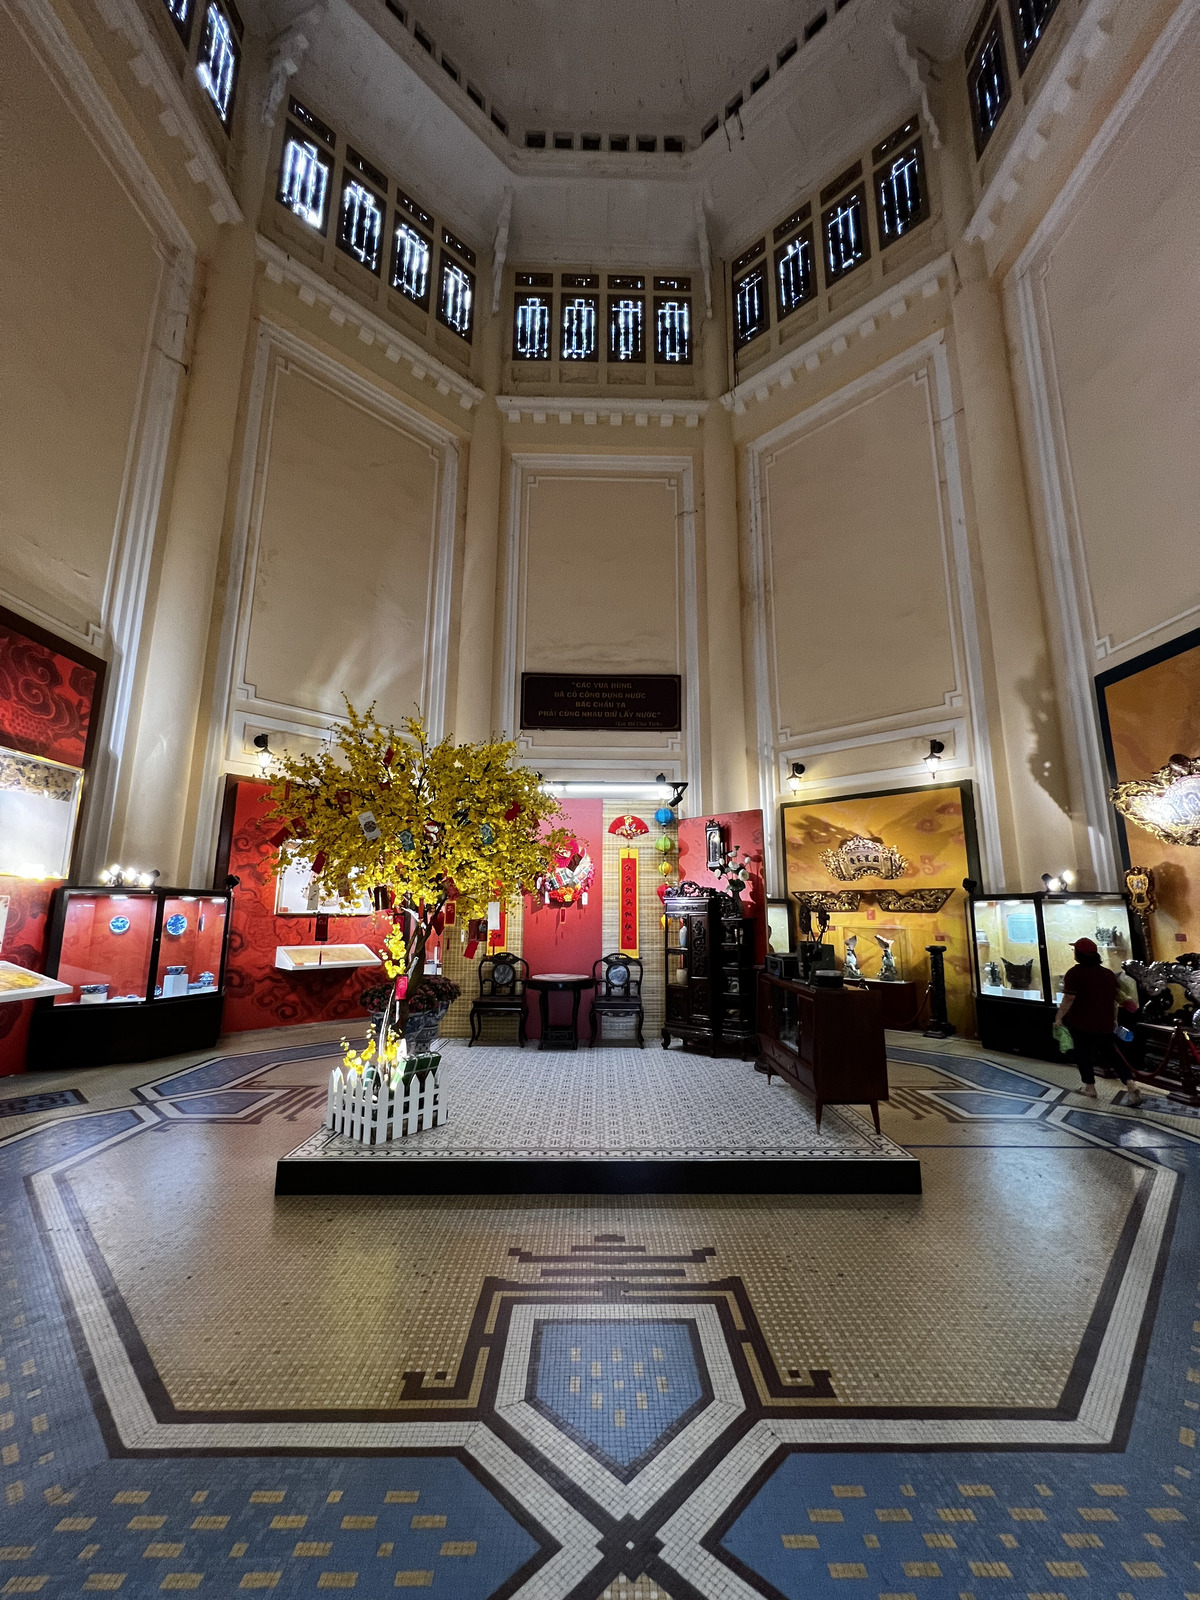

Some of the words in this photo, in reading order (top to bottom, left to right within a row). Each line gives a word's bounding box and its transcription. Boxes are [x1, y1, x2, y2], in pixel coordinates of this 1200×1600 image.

[593, 700, 614, 708] CHÁU
[538, 708, 556, 716] PHẢI
[558, 708, 580, 717] CÙNG
[619, 710, 634, 718] LẤY
